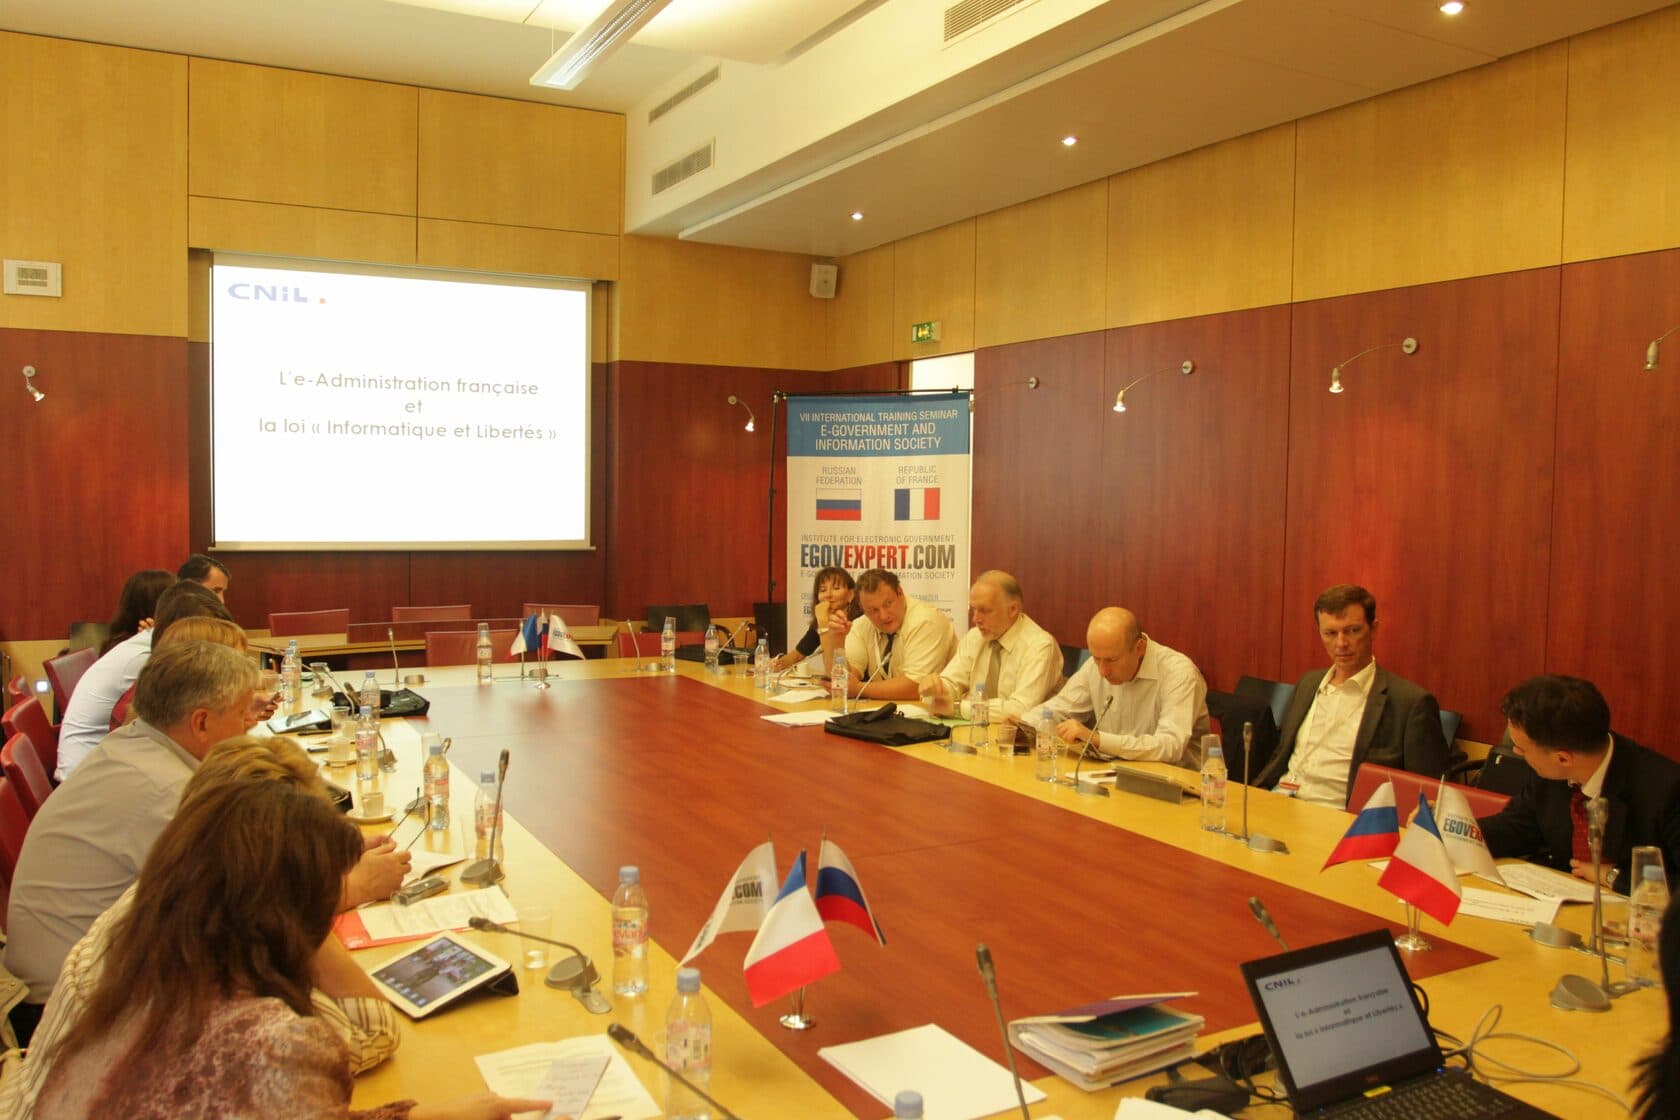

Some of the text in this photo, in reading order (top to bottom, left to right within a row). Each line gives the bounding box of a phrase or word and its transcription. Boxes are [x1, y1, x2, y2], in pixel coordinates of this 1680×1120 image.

[279, 371, 539, 397] L'e-Administration française
[405, 400, 423, 413] et
[799, 409, 958, 422] VII INTERNATIONAL TRAINING SEMINAR
[259, 418, 277, 432] la
[284, 418, 305, 434] loi
[327, 420, 447, 440] Informatique
[454, 424, 471, 438] et
[476, 424, 544, 440] Libertés
[820, 422, 936, 437] E-GOVERNMENT AND
[815, 436, 942, 451] INFORMATION SOCIETY
[822, 466, 857, 475] RUSSIAN
[898, 465, 937, 474] REPUBLIC
[816, 476, 862, 485] FEDERATION
[896, 475, 939, 485] OF FRANCE
[801, 535, 837, 543] INSTITUTE
[856, 535, 902, 544] ELECTRONIC
[903, 534, 955, 543] GOVERNMENT
[800, 544, 956, 570] EGOVEXPERT.COM
